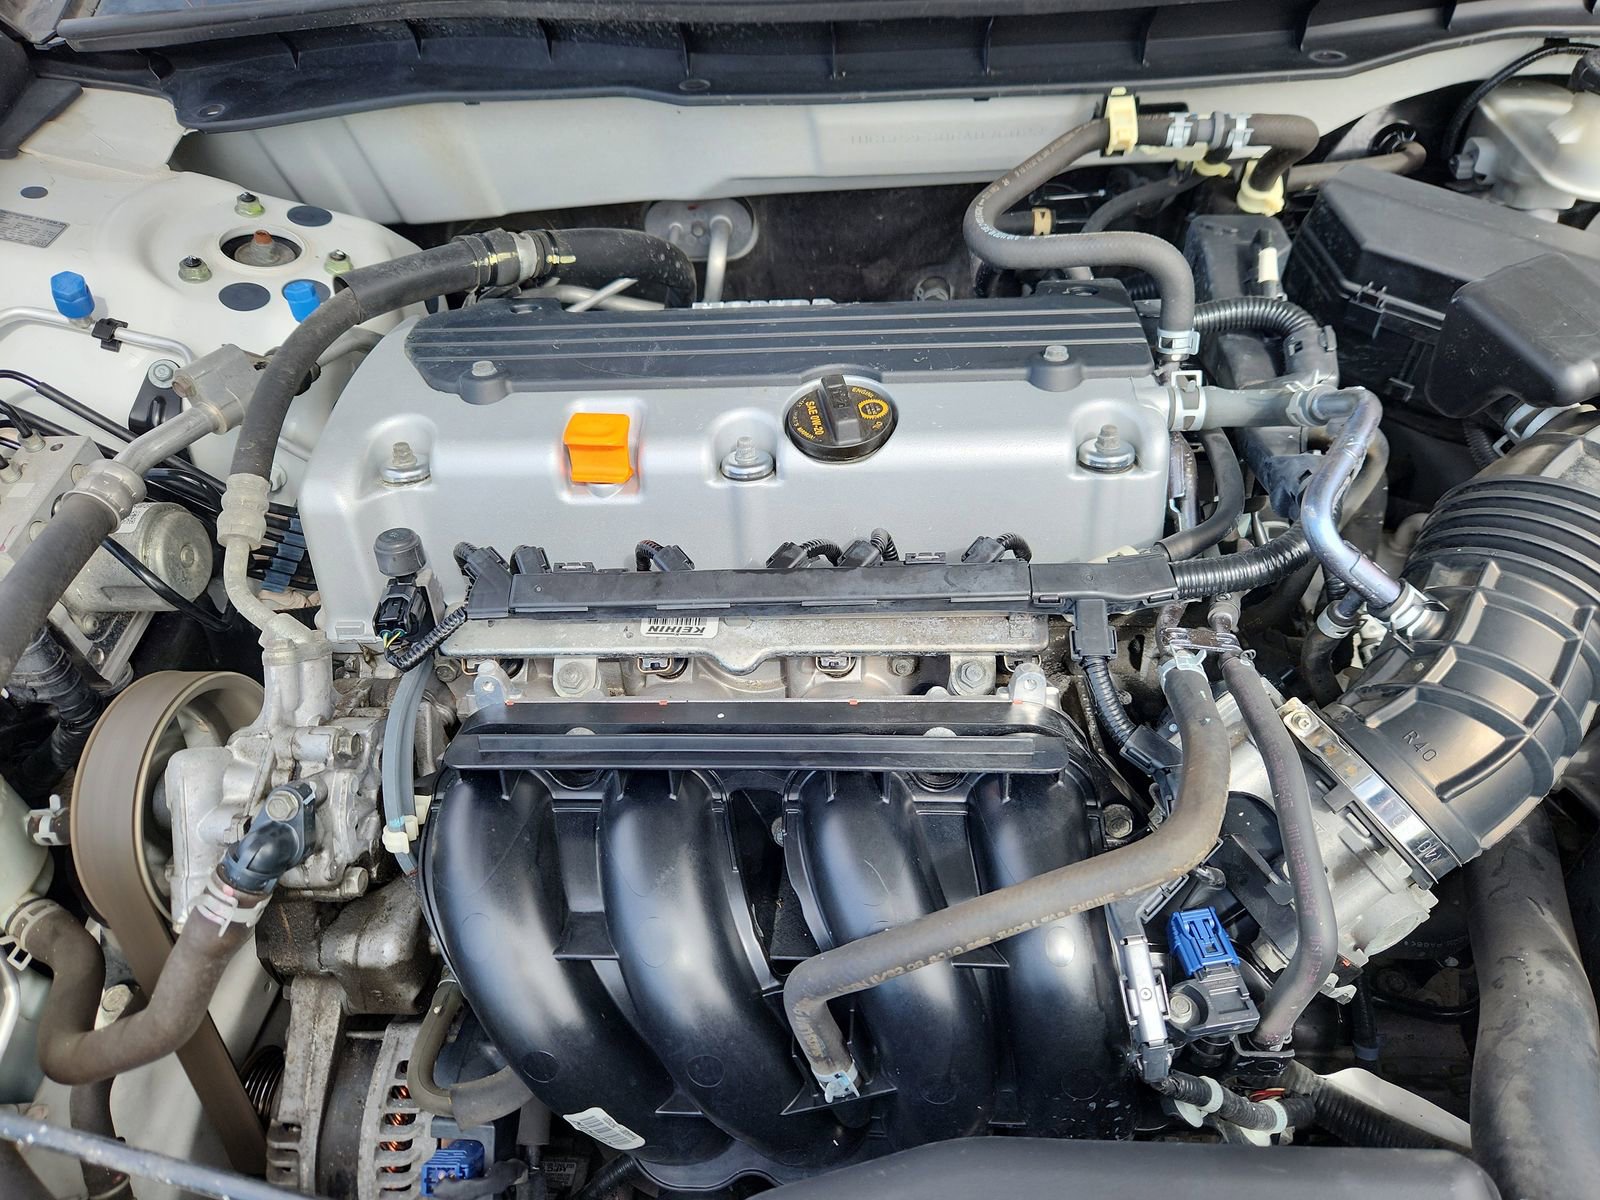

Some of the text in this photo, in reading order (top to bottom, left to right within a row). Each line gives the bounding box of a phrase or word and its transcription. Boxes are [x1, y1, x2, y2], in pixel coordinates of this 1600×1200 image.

[851, 386, 877, 399] ENGIN
[805, 401, 818, 416] SAE
[810, 415, 825, 436] 0W-20
[648, 625, 706, 633] KEIHIN
[1402, 729, 1437, 762] R40
[1069, 892, 1116, 914] ENGINE
